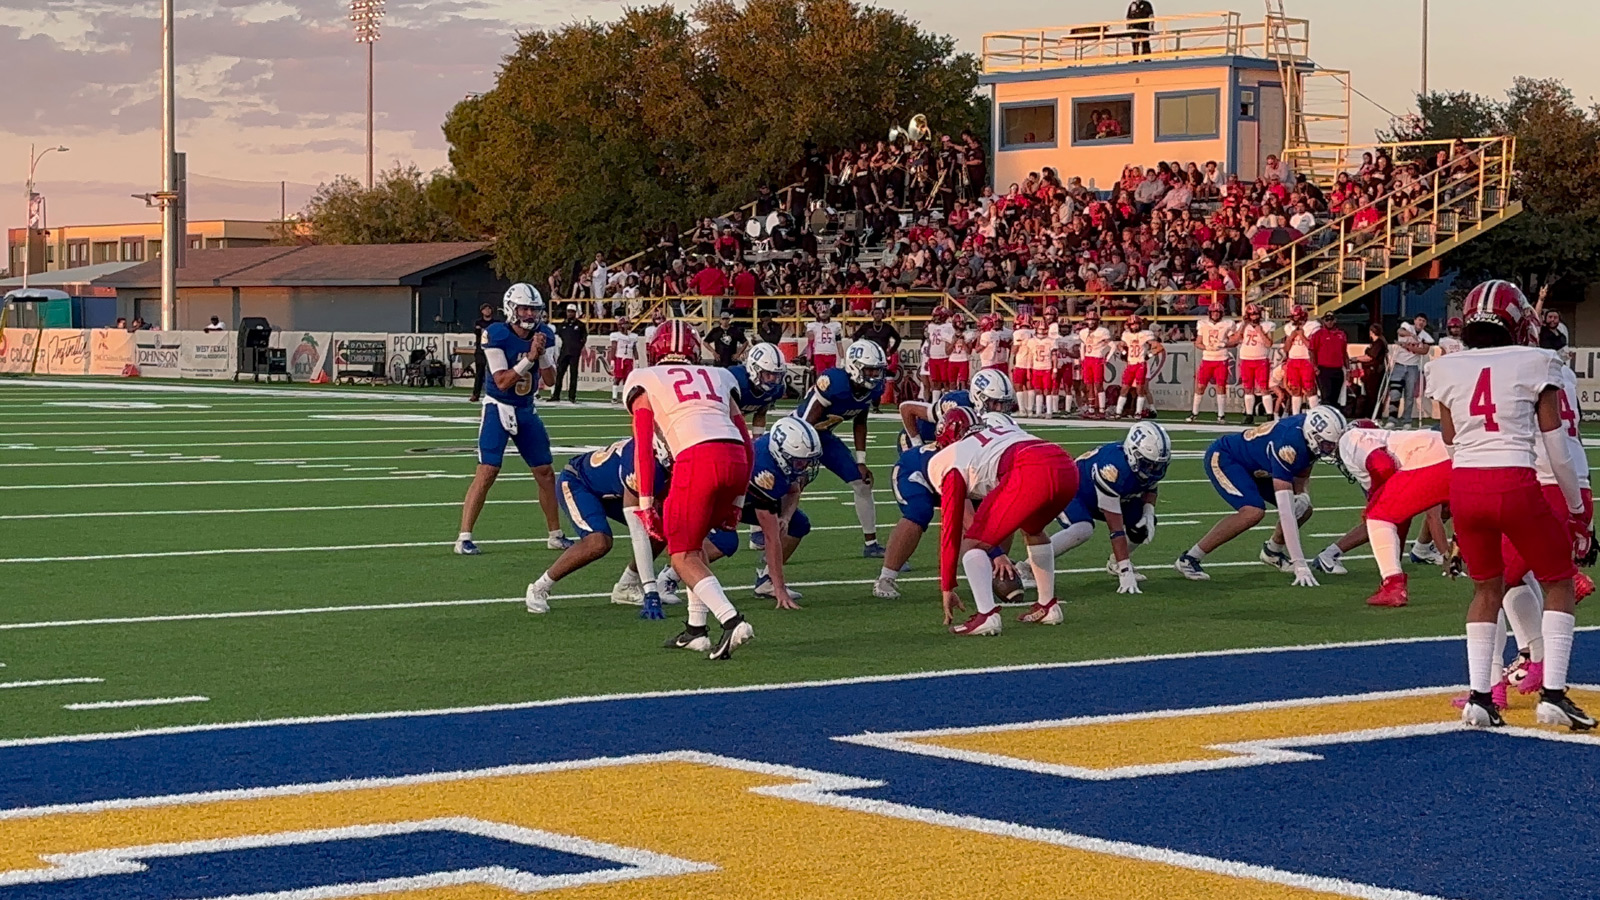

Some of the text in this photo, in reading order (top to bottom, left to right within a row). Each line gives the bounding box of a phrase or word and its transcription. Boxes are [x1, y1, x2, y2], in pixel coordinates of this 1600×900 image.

[11, 347, 45, 363] COLLIR
[138, 350, 178, 363] JOHNSON
[196, 345, 209, 353] WEST
[750, 347, 764, 361] 10
[849, 347, 864, 359] 20
[667, 368, 723, 403] 21
[1469, 367, 1499, 432] 4
[1310, 414, 1328, 433] 58
[1130, 428, 1146, 447] 51
